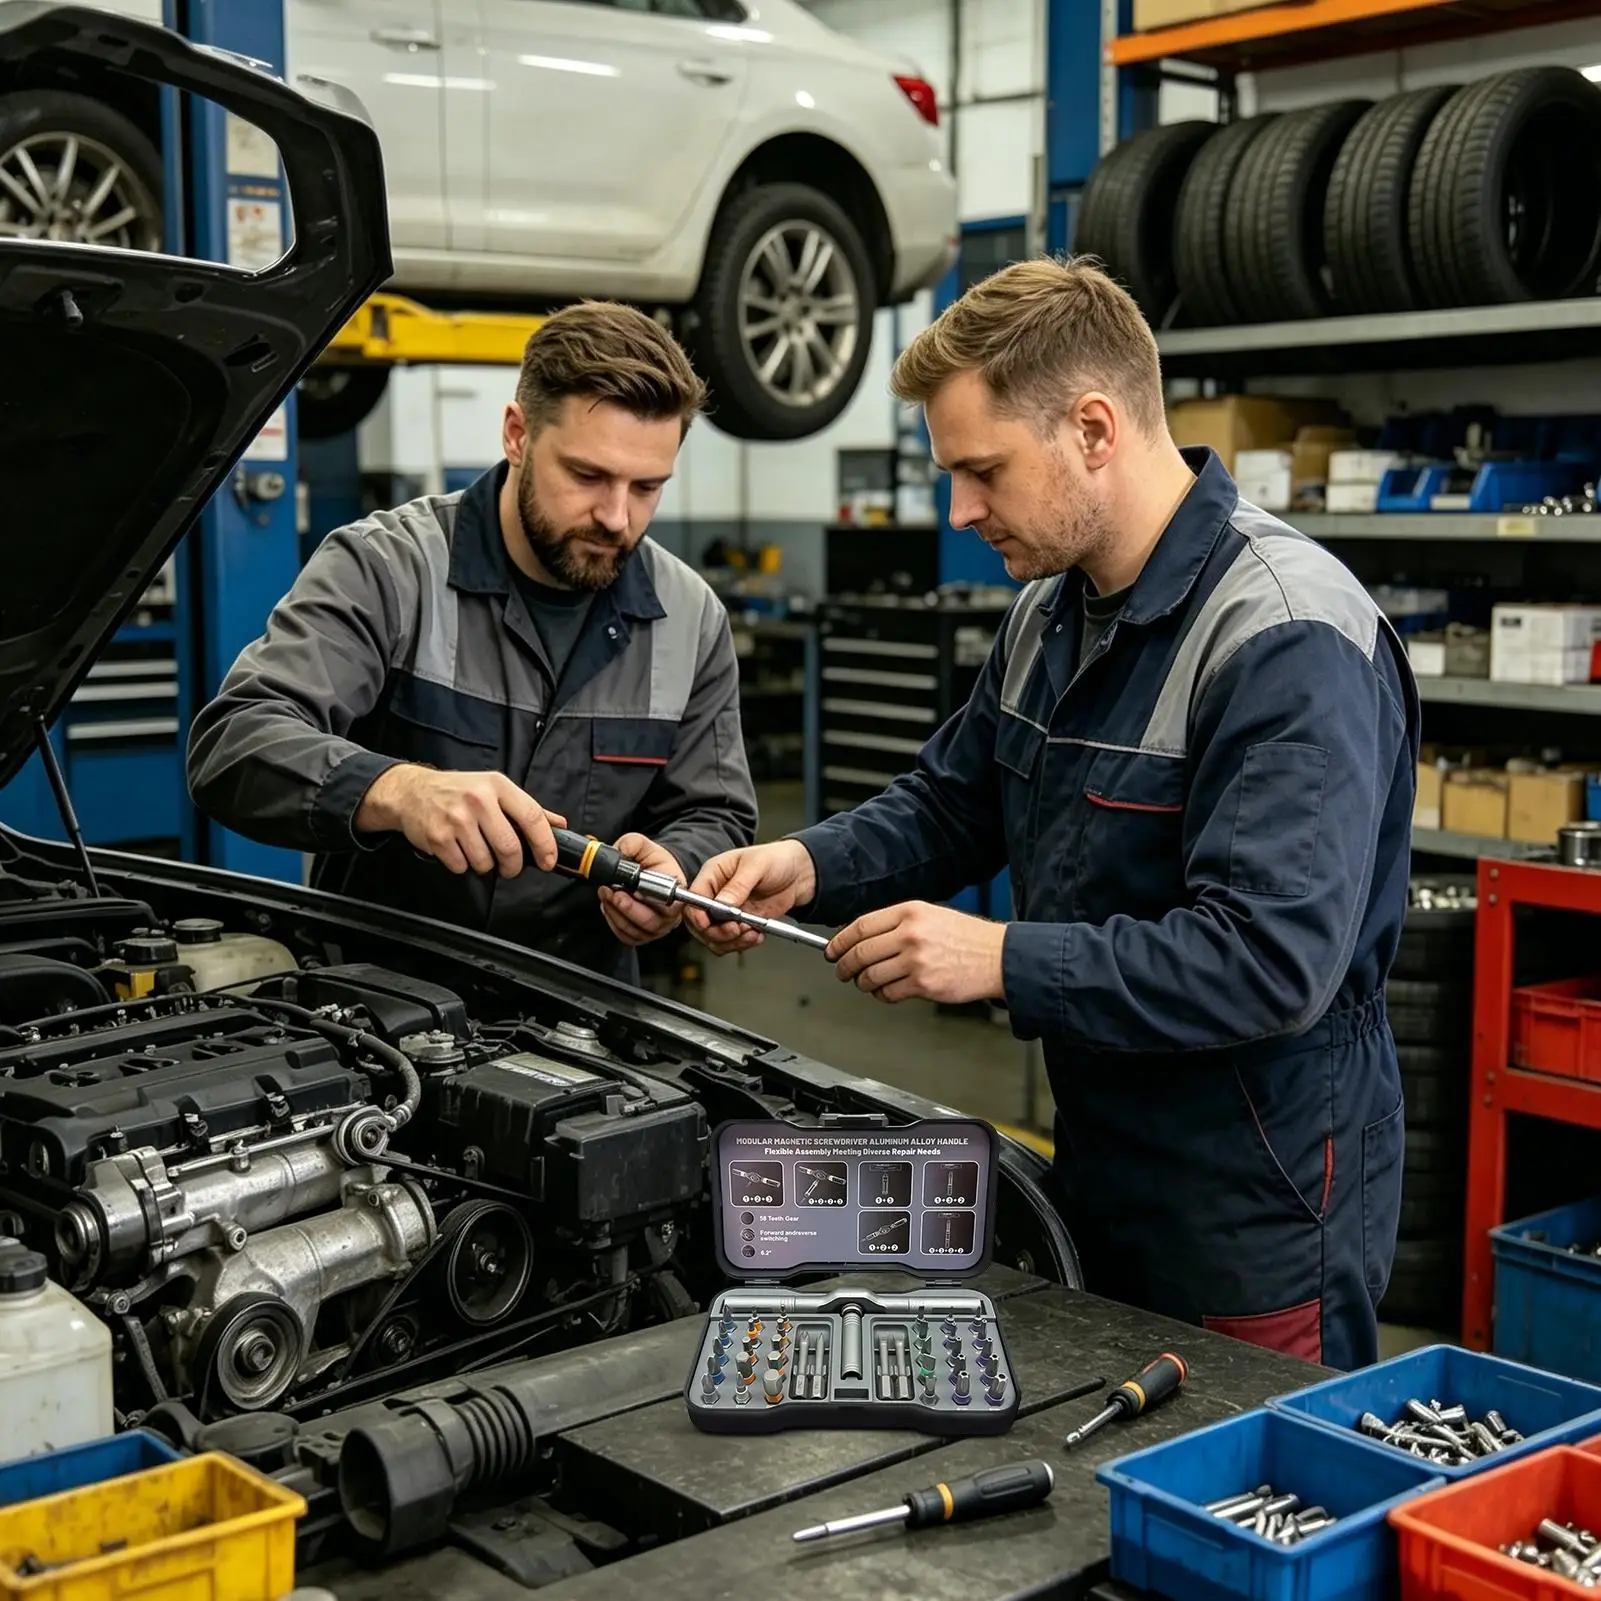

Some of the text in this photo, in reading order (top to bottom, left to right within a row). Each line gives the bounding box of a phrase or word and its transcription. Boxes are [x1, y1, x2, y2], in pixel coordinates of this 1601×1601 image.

[736, 1137, 969, 1145] MODULAR MAGNETIC SCREWDRIVER ALUMINUM ALLOY HANDLE
[764, 1147, 941, 1157] Flexible Assembly Meeting Diverse Repair Needs
